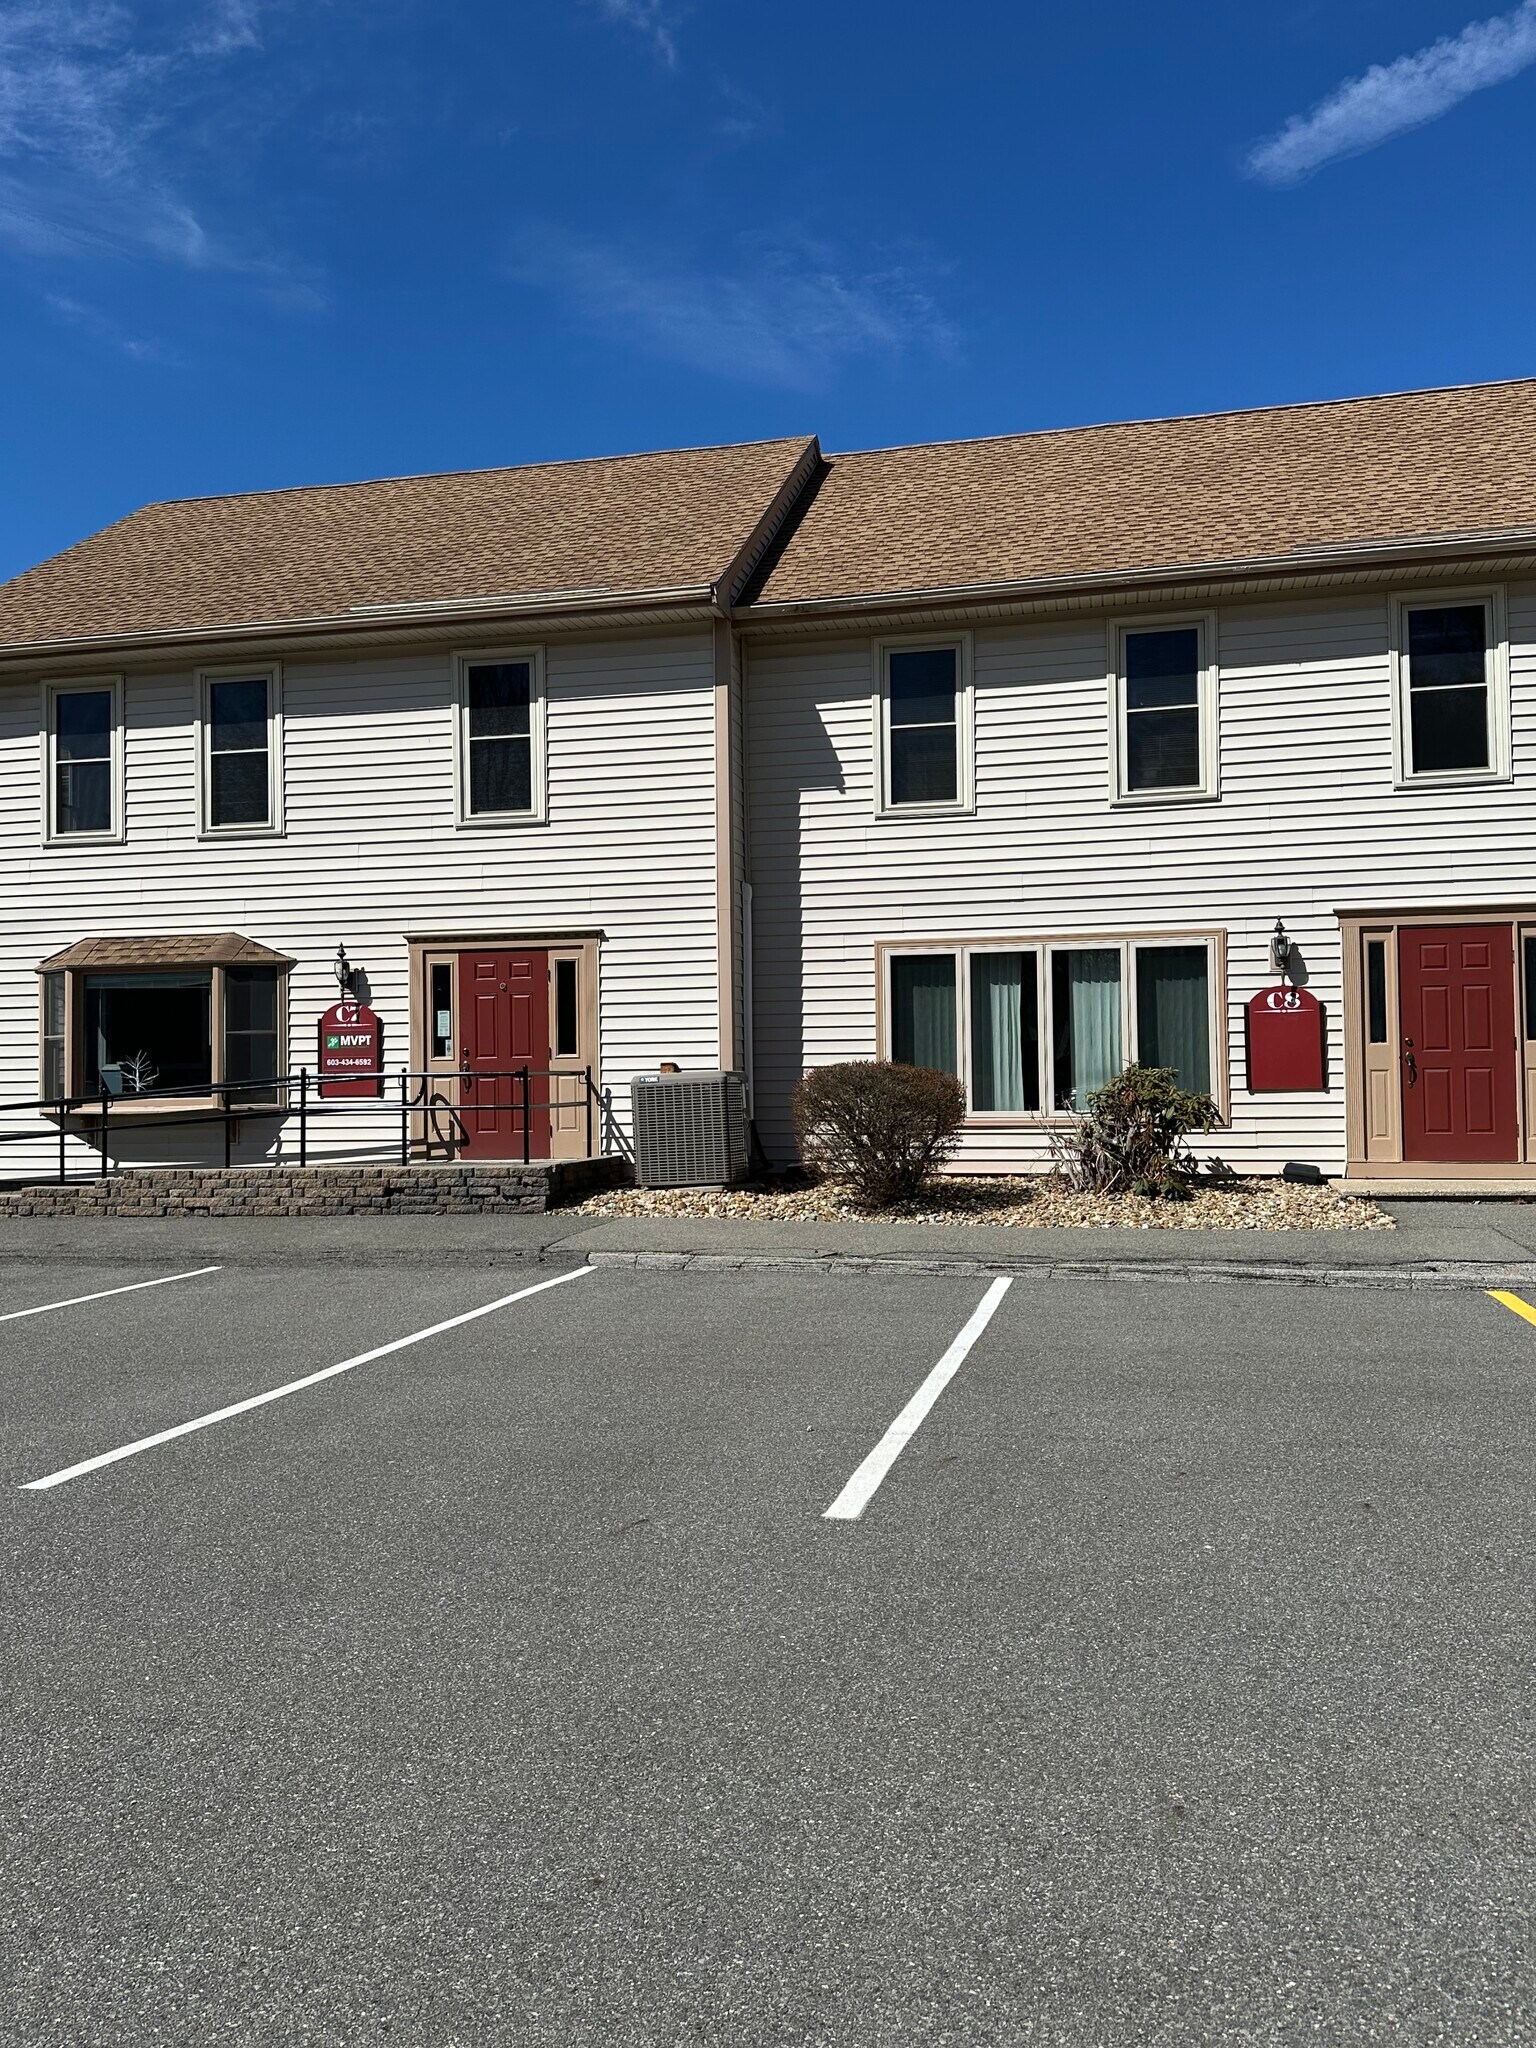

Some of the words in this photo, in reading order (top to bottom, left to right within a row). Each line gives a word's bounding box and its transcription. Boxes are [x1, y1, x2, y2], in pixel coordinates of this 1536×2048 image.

[1266, 991, 1301, 1009] C8
[335, 1005, 362, 1022] C7
[340, 1035, 371, 1046] MVPT
[326, 1058, 372, 1066] 603-434-6592
